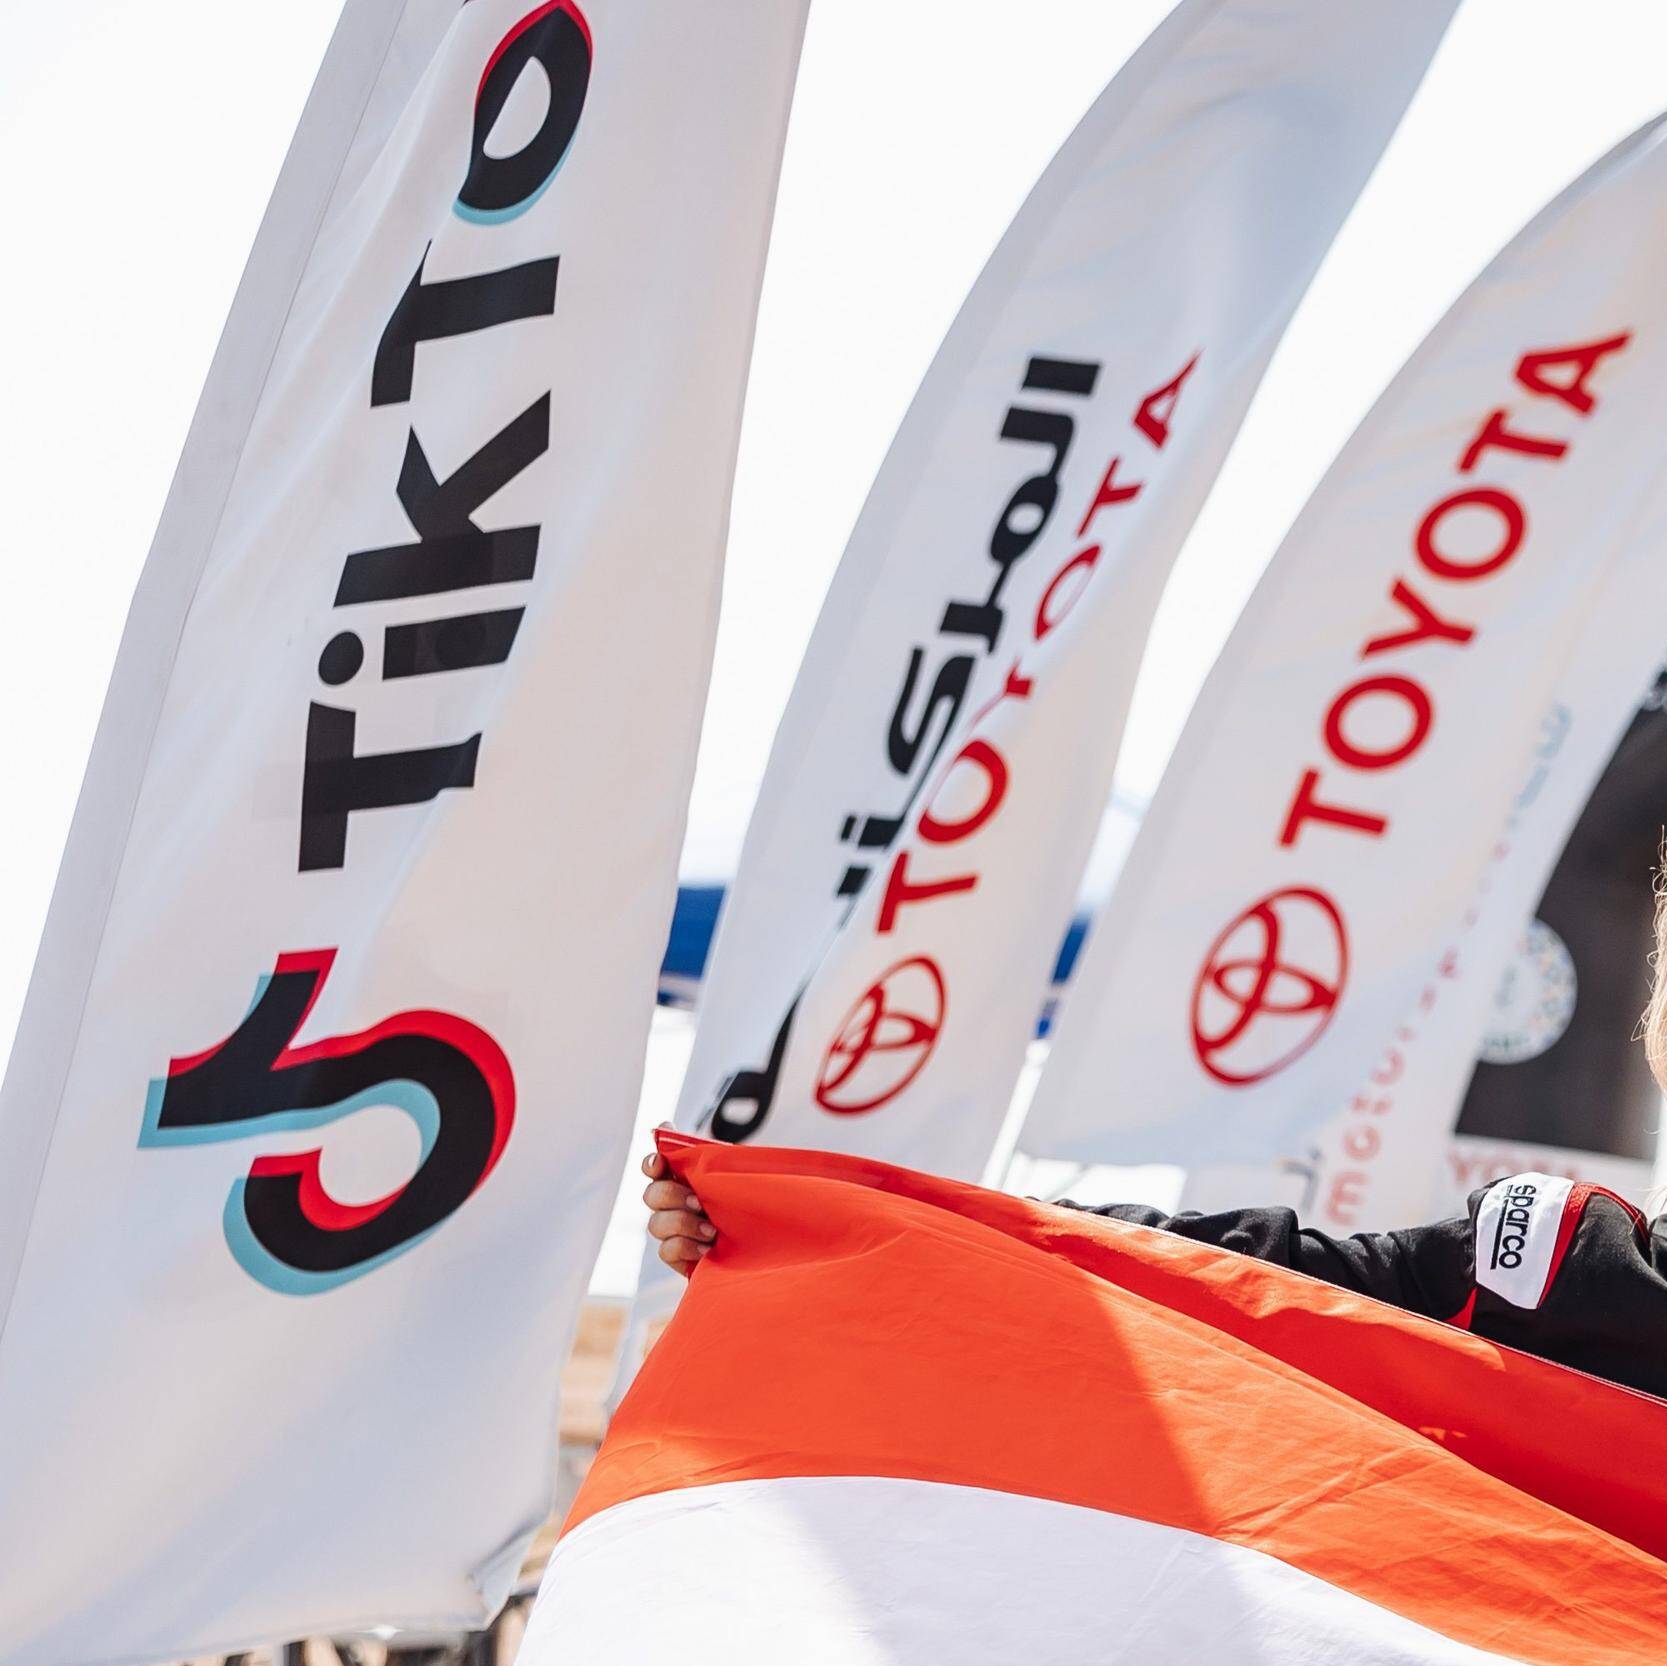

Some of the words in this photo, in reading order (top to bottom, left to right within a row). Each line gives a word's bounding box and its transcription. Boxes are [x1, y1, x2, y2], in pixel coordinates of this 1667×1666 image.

[298, 0, 594, 874] TikTo
[874, 349, 1203, 934] TOYOTA
[1279, 328, 1632, 850] TOYOTA
[1497, 1184, 1537, 1270] sparco
